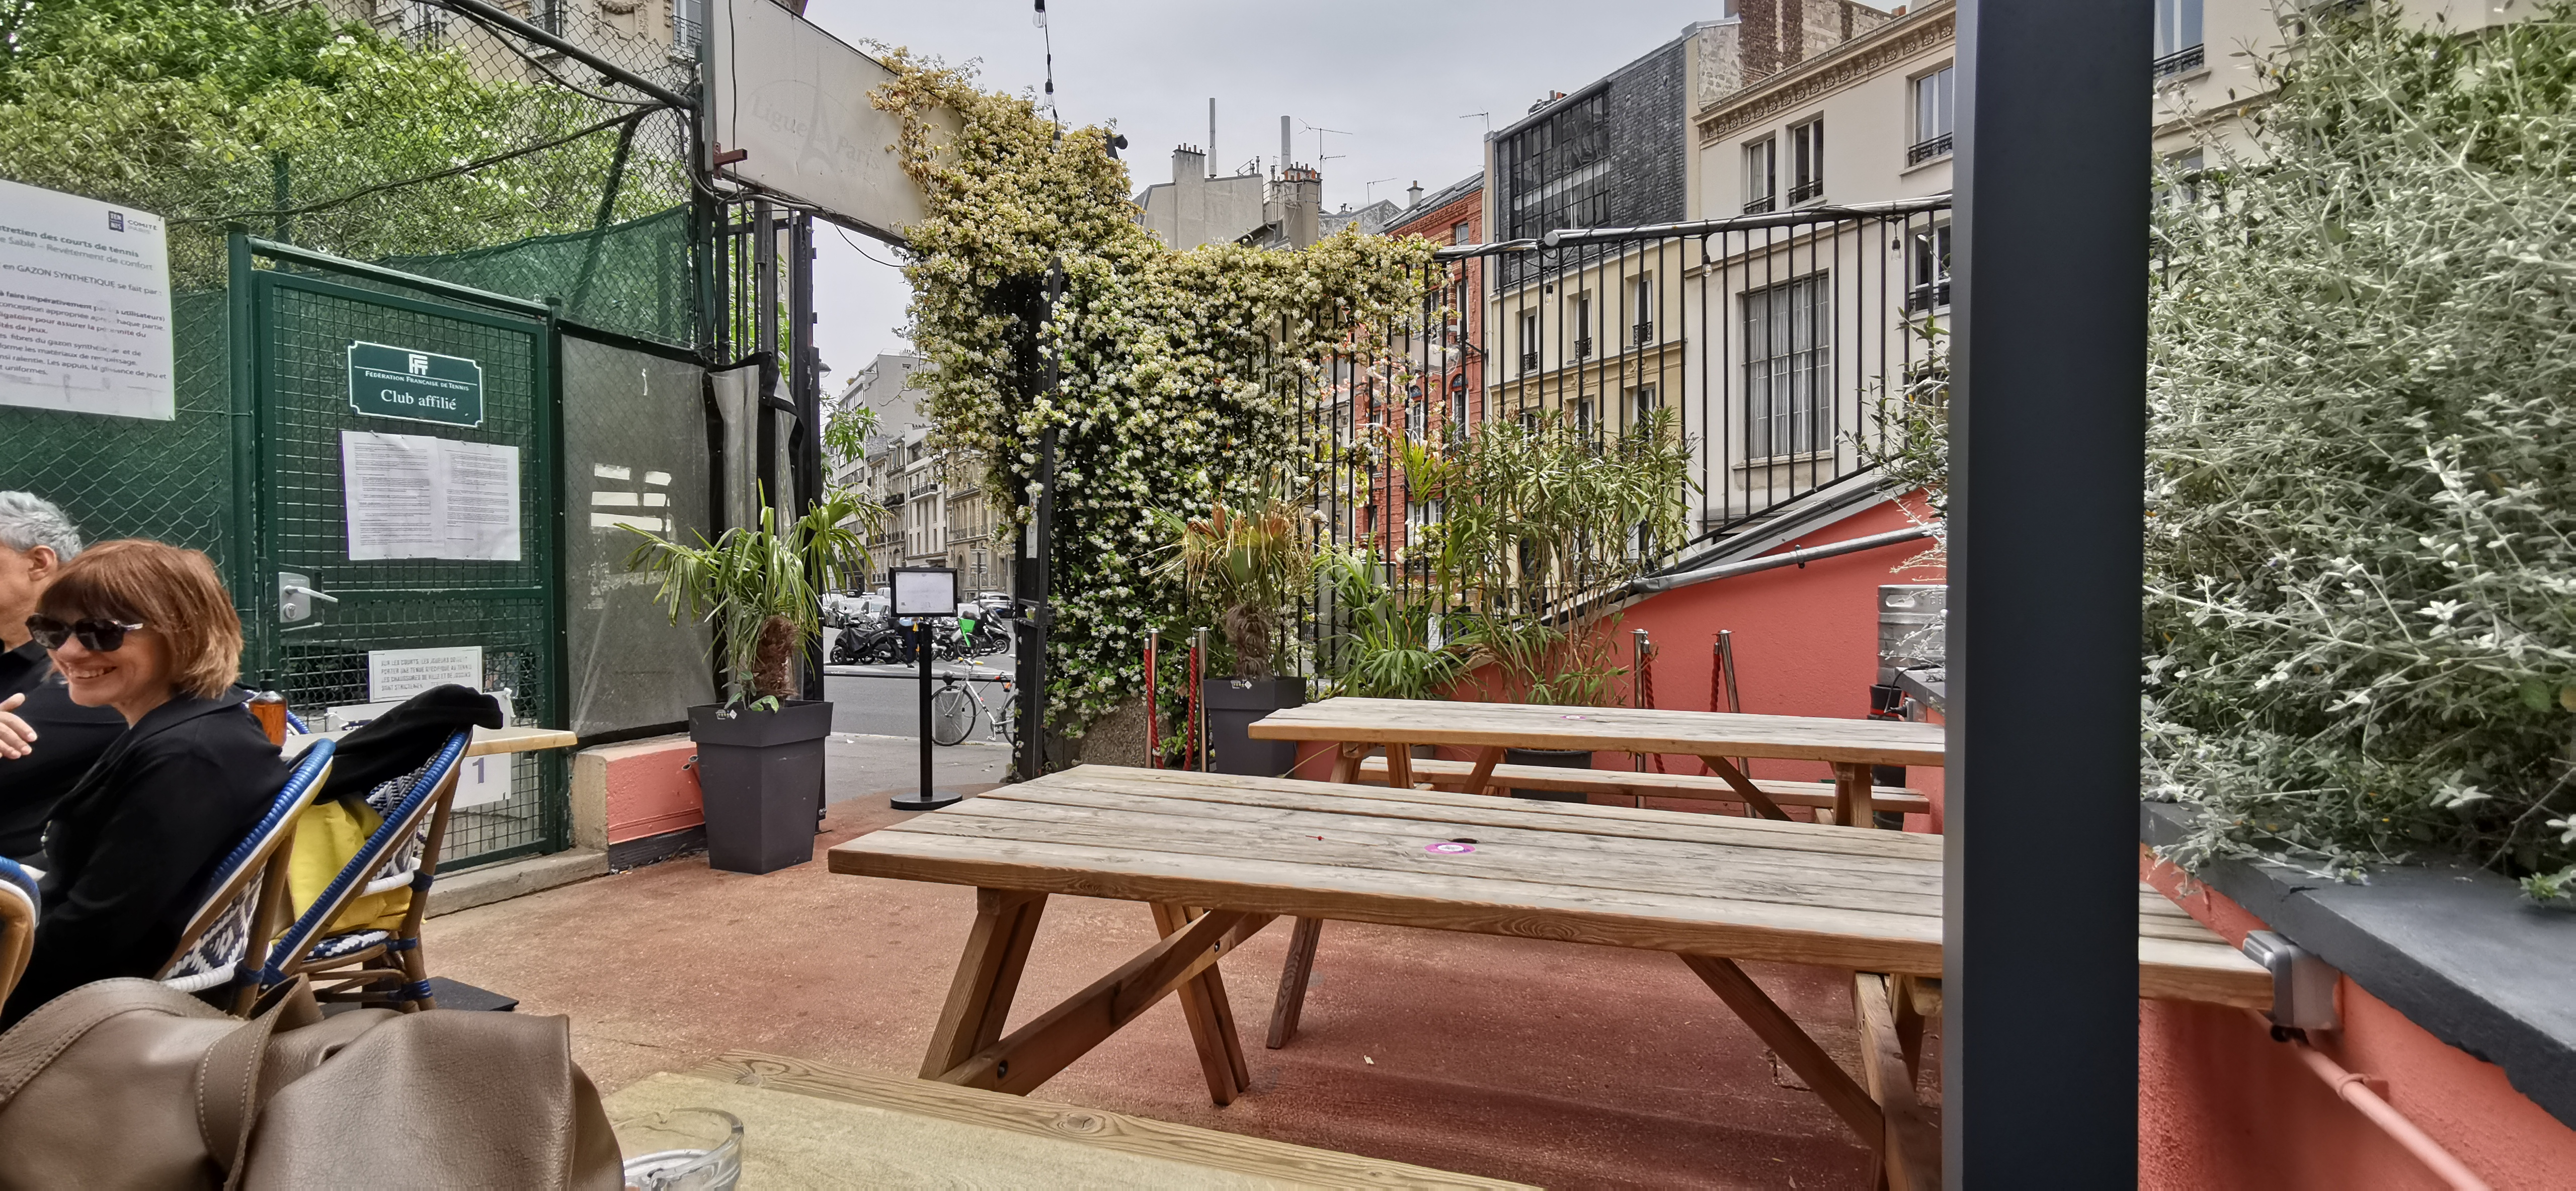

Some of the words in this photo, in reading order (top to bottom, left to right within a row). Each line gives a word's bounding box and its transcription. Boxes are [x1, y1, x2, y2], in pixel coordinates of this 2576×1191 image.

[752, 95, 808, 137] Ligue
[0, 226, 37, 237] tretien
[40, 232, 58, 241] des
[60, 237, 93, 248] courts
[109, 246, 139, 258] tennis
[46, 243, 104, 261] Revêtement
[106, 256, 118, 264] de
[120, 260, 153, 271] confort
[17, 265, 51, 276] GAZON
[128, 284, 142, 292] fait
[6, 291, 25, 299] faire
[27, 295, 92, 309] impérativement
[121, 310, 165, 322] utilisateurs)
[46, 307, 89, 319] appropriée
[115, 318, 141, 327] haque
[35, 317, 55, 325] pour
[57, 320, 86, 329] assurer
[11, 333, 33, 343] fibres
[38, 349, 77, 358] matériaux
[409, 354, 428, 376] FFT
[449, 382, 469, 391] TENNIS
[381, 389, 414, 404] Club
[418, 395, 457, 410] affilié
[472, 757, 485, 784] 1
